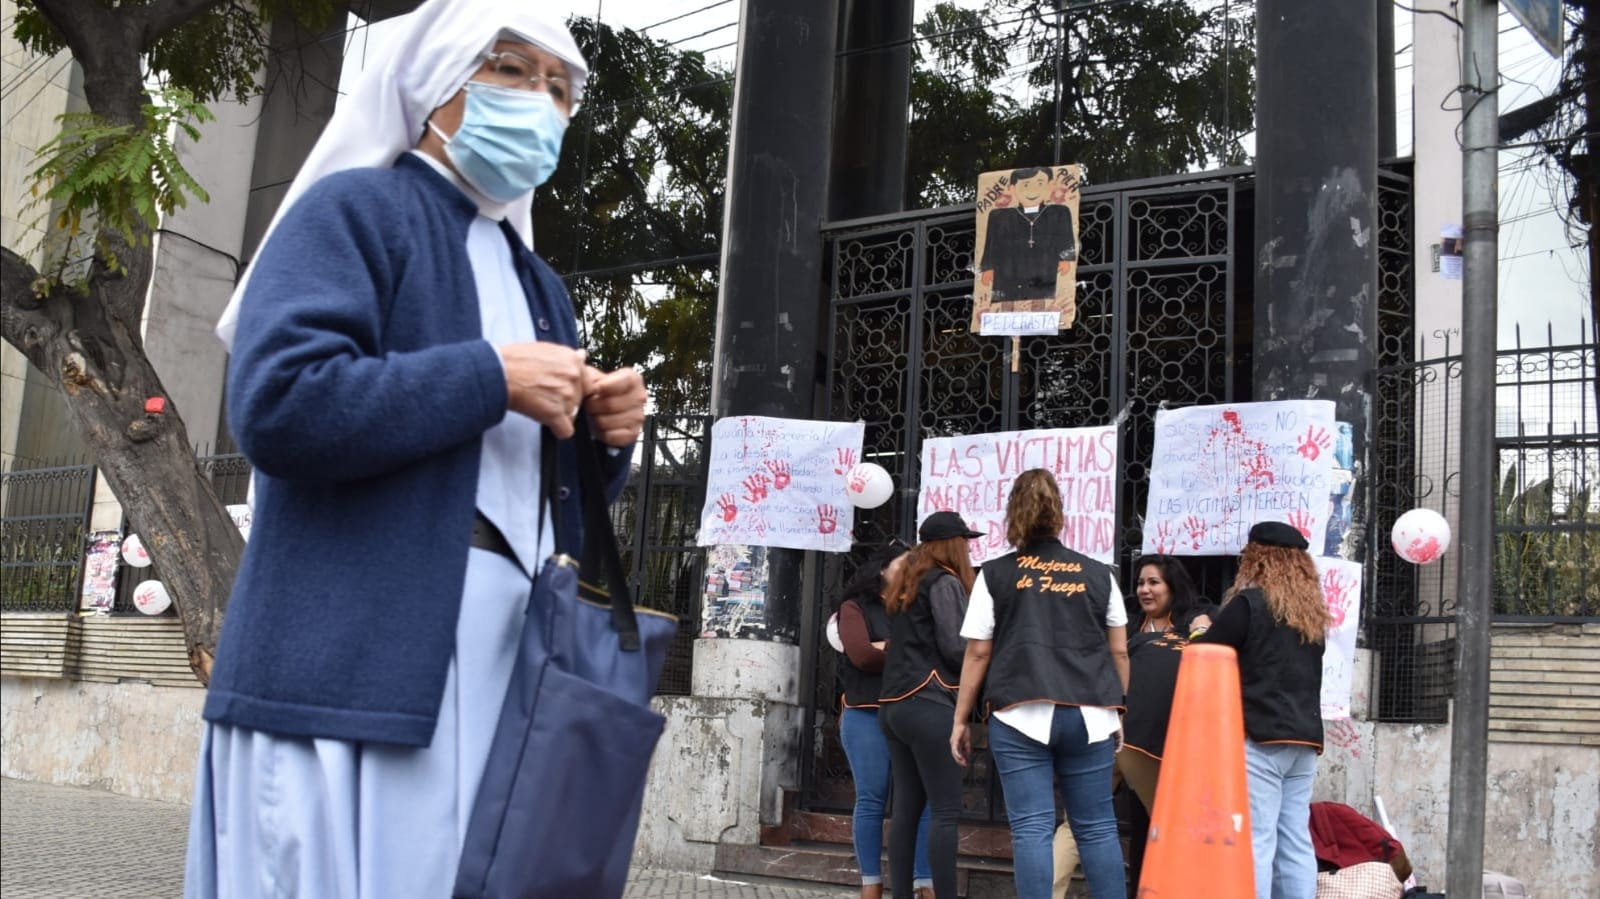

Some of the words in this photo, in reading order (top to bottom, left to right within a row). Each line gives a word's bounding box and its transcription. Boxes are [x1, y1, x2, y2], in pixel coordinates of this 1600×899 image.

[976, 175, 1009, 214] PADRE
[983, 313, 1057, 331] PEDERASTA
[1275, 410, 1298, 432] NO
[930, 445, 983, 478] LAS
[995, 431, 1115, 475] VÍCTIMAS
[924, 478, 1010, 513] MERECE
[1247, 488, 1310, 511] MERECEN
[1016, 555, 1082, 575] Mujeres
[1016, 574, 1034, 590] de
[1039, 576, 1087, 597] Fuego
